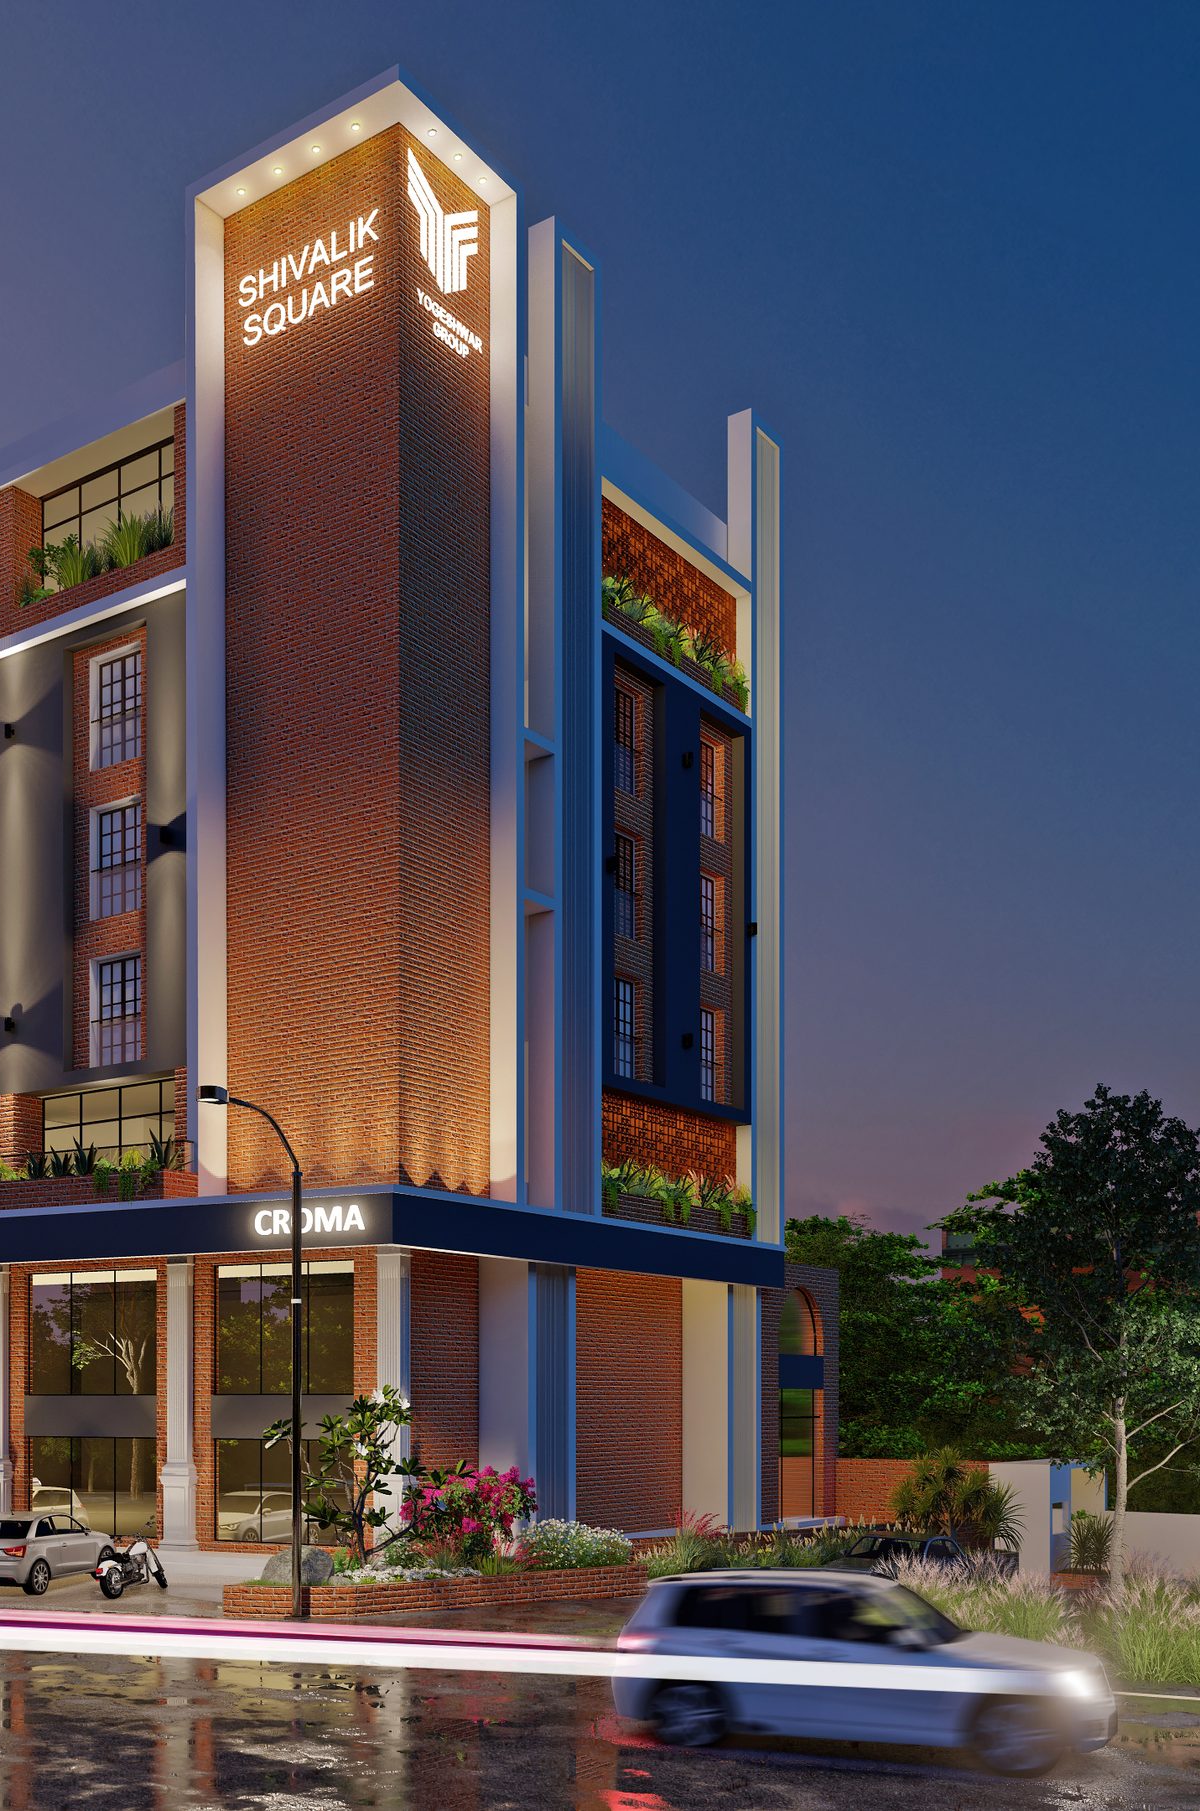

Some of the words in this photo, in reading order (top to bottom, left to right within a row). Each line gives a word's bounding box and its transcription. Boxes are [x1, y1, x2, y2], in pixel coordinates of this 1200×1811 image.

[238, 208, 380, 307] SHIVALIK
[242, 255, 375, 346] SQUARE
[432, 321, 470, 358] GROUP
[254, 1204, 366, 1236] CROMA
